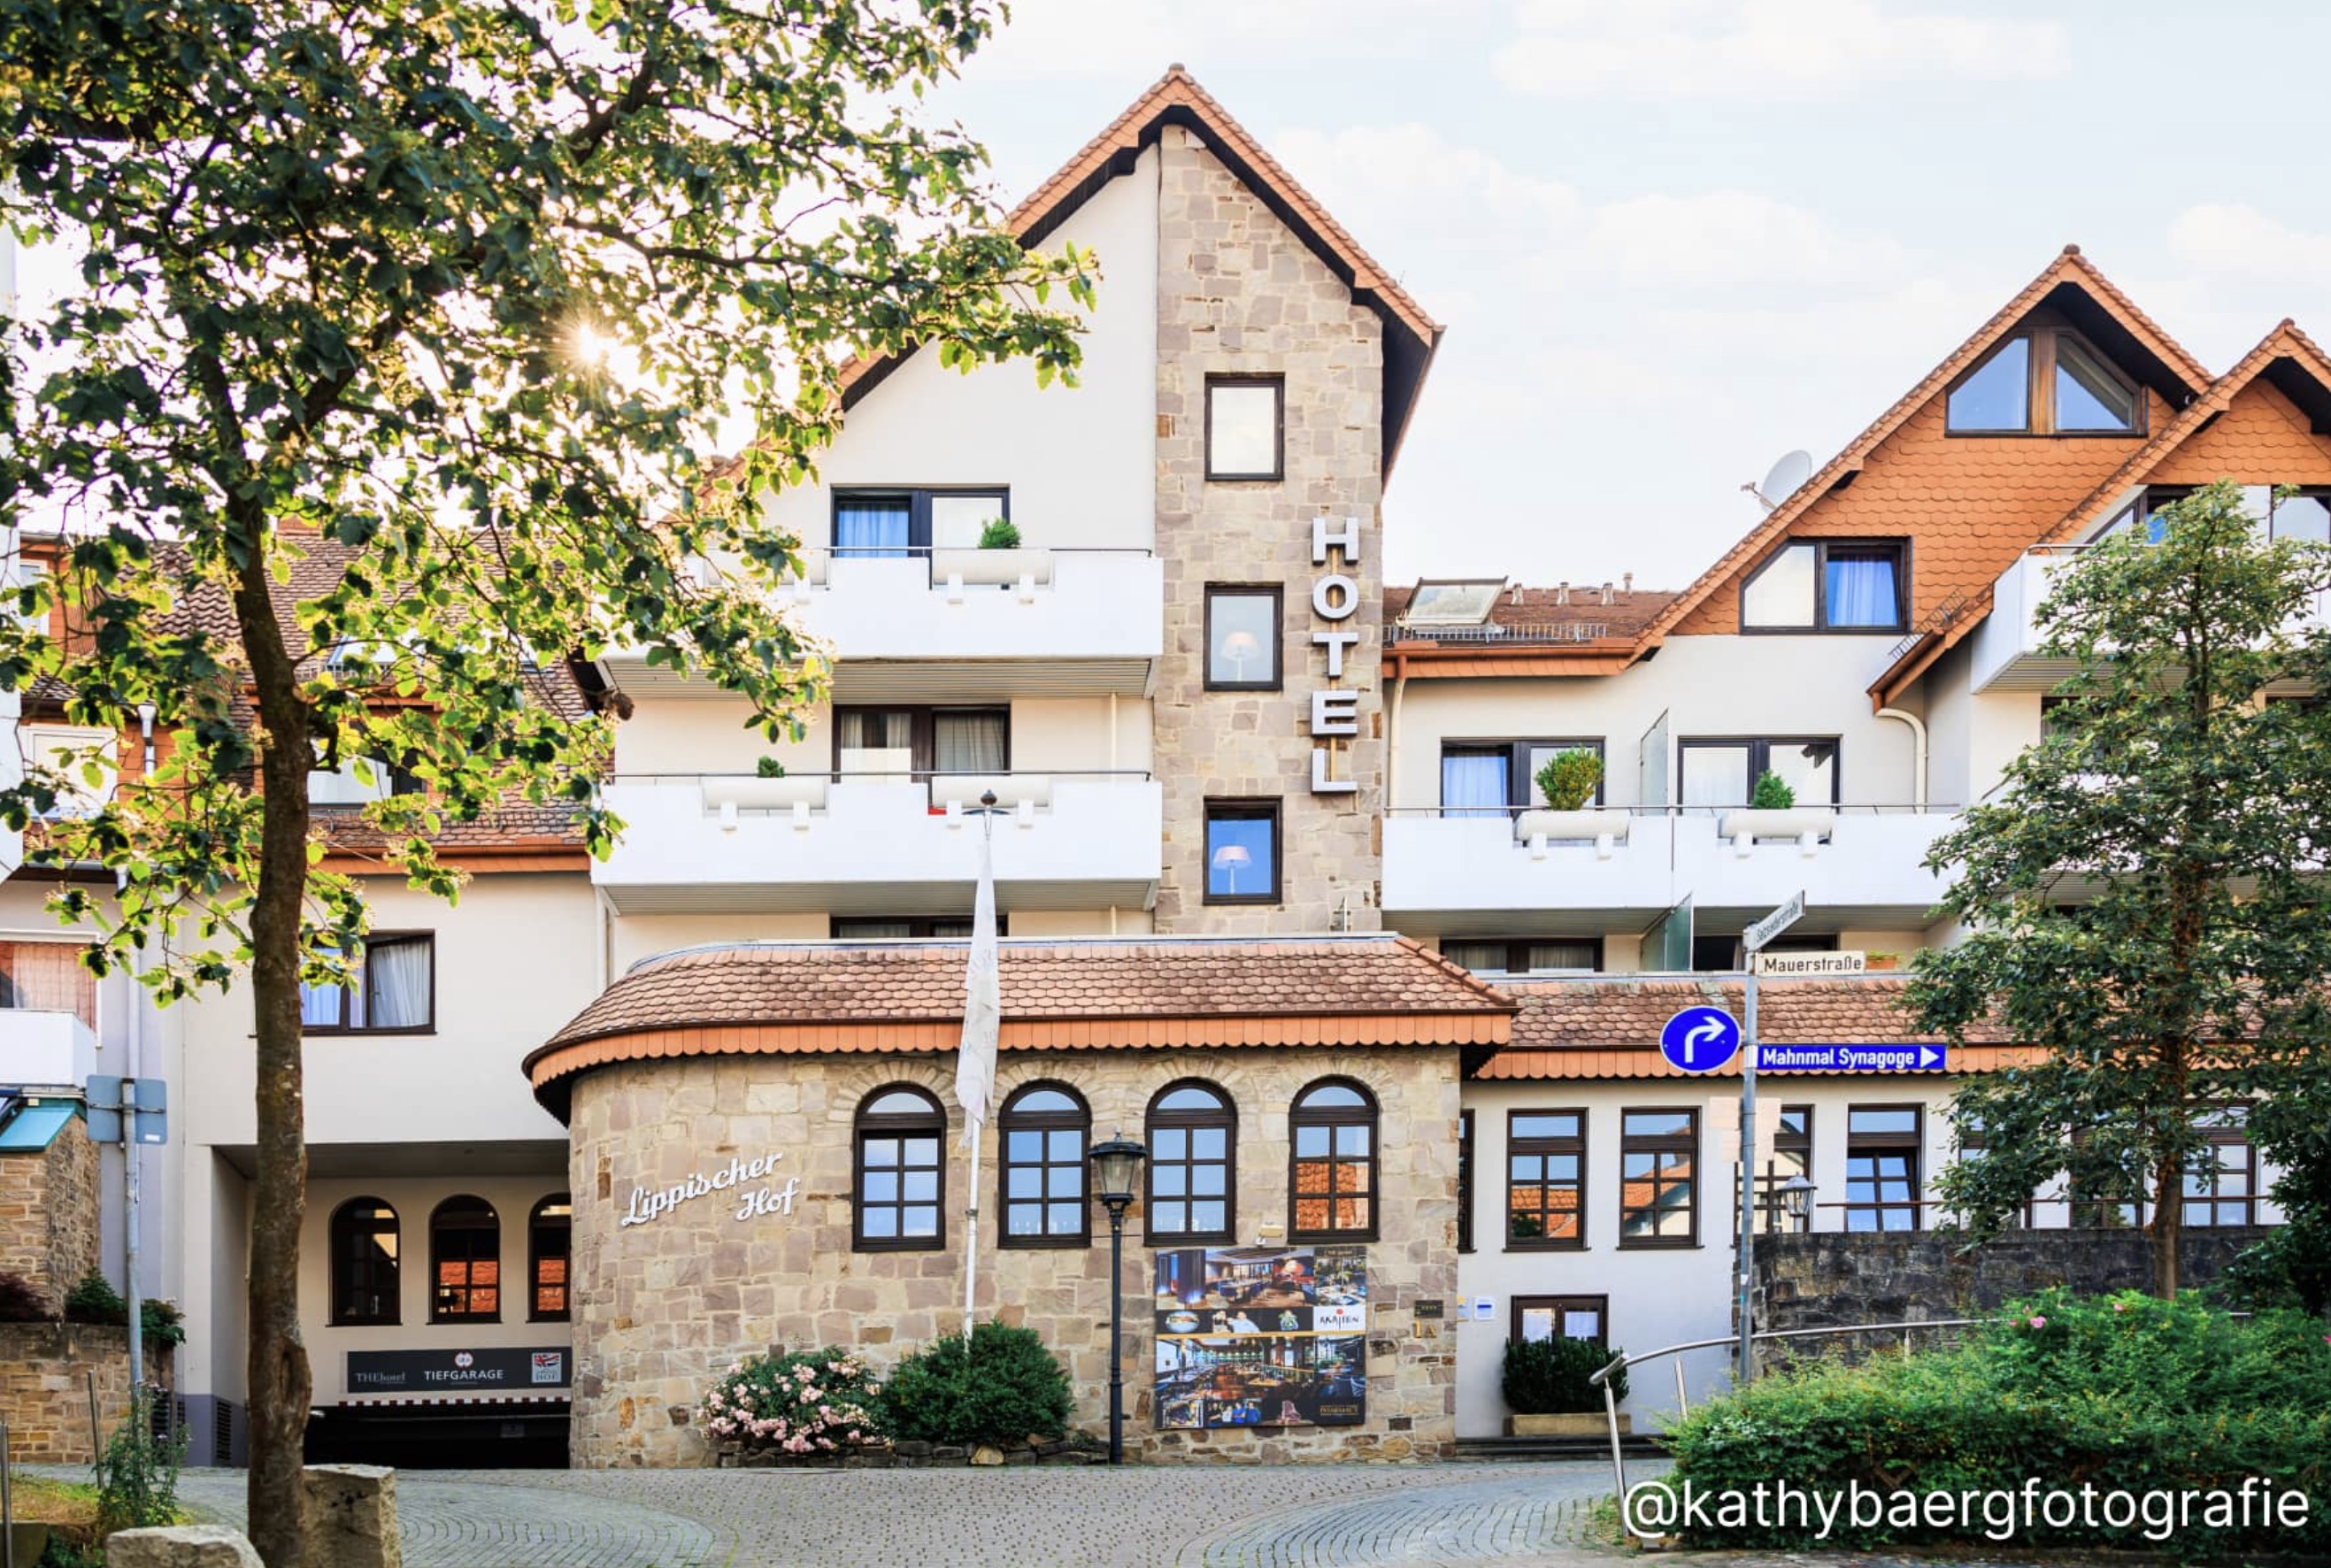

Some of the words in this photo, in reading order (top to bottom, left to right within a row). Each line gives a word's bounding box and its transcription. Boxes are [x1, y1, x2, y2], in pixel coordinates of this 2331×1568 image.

[1312, 517, 1359, 793] HOTEL
[1764, 956, 1862, 972] Mauerstraße
[1763, 1048, 1835, 1066] Mahnmal
[1838, 1048, 1915, 1069] Synagoge
[621, 1152, 783, 1226] Lippischer
[736, 1177, 800, 1221] Hof
[424, 1369, 504, 1381] TIEFGARAGE
